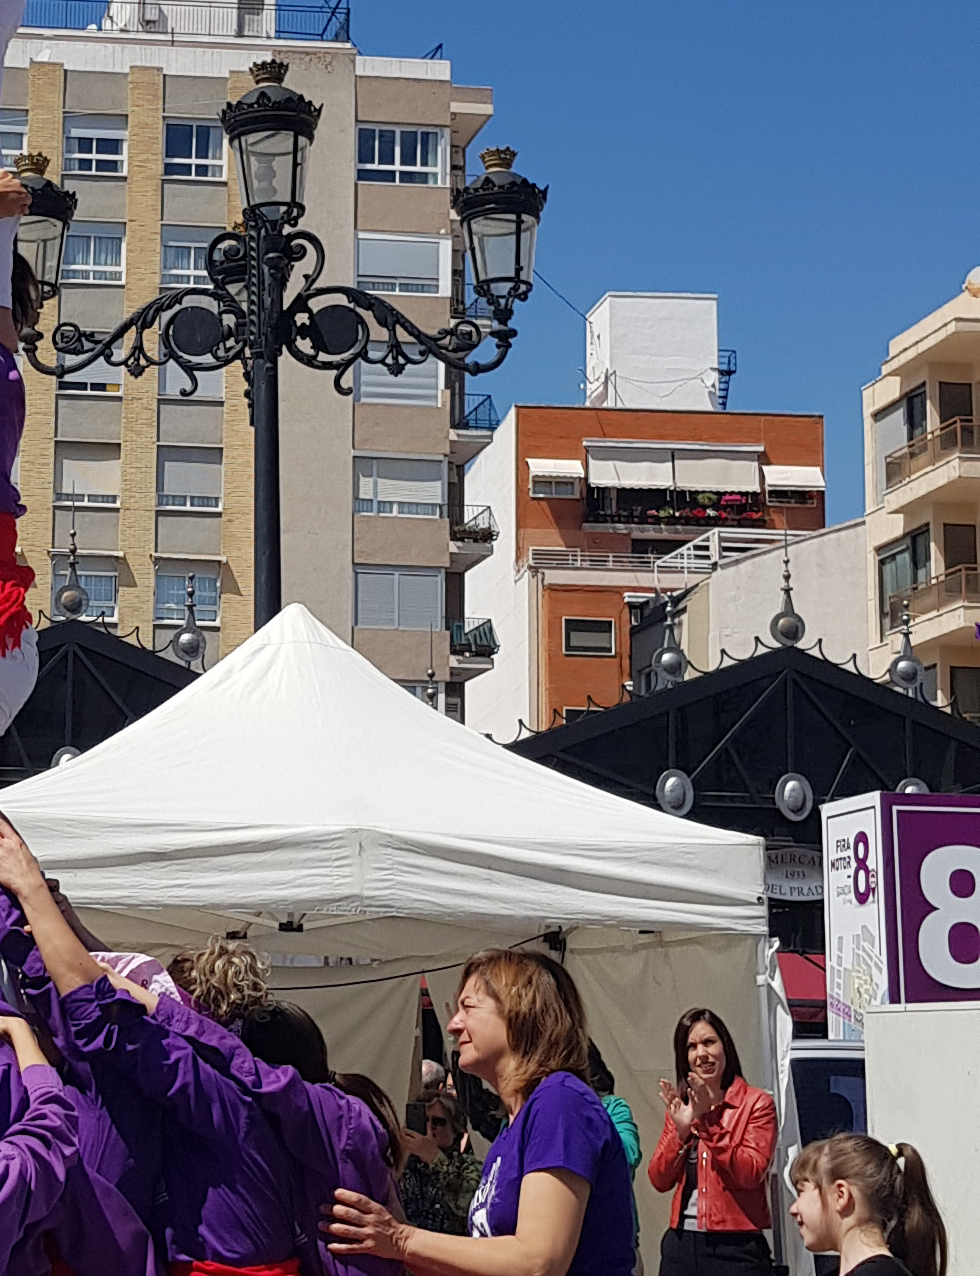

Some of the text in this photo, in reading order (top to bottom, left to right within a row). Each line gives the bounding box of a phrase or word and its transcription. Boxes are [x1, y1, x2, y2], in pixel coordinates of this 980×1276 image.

[836, 837, 851, 854] FIRA
[767, 854, 823, 869] MERCAT
[830, 855, 852, 873] MOTOR
[918, 845, 980, 989] 8
